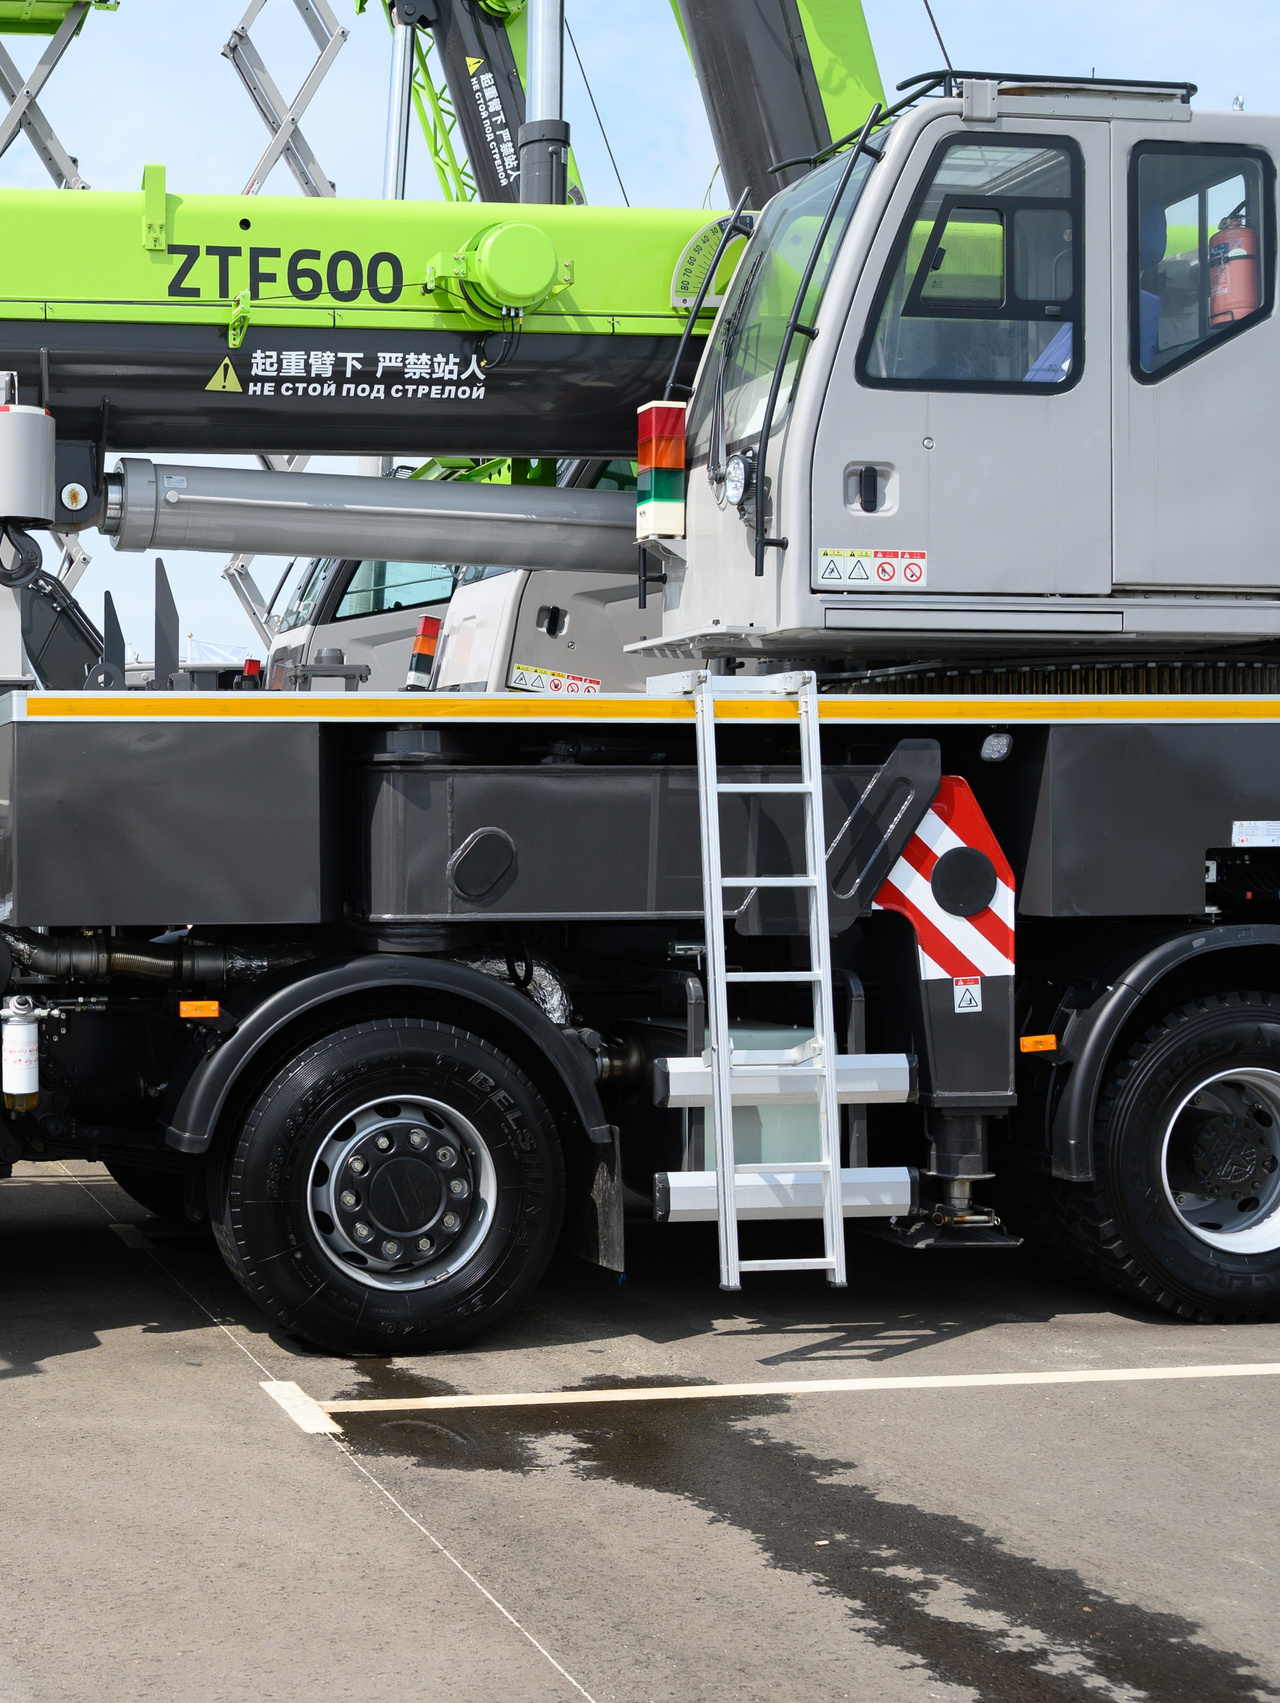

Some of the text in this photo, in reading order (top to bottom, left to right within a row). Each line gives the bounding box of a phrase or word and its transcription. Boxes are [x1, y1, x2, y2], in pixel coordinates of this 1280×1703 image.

[470, 76, 509, 187] НЕ СТОЙ ПОД СТРЕЛОЙ
[710, 227, 719, 236] 30
[701, 235, 710, 244] 40
[693, 244, 703, 255] 50
[687, 256, 697, 266] 60
[167, 244, 404, 303] ZTF600
[683, 267, 693, 278] 70
[680, 280, 690, 291] 80
[251, 349, 486, 380] 起重臂下 严禁站人
[248, 380, 486, 399] НЕ СТОЙ ПОД СТРЕЛОЙ
[469, 1069, 543, 1248] BELSHINA
